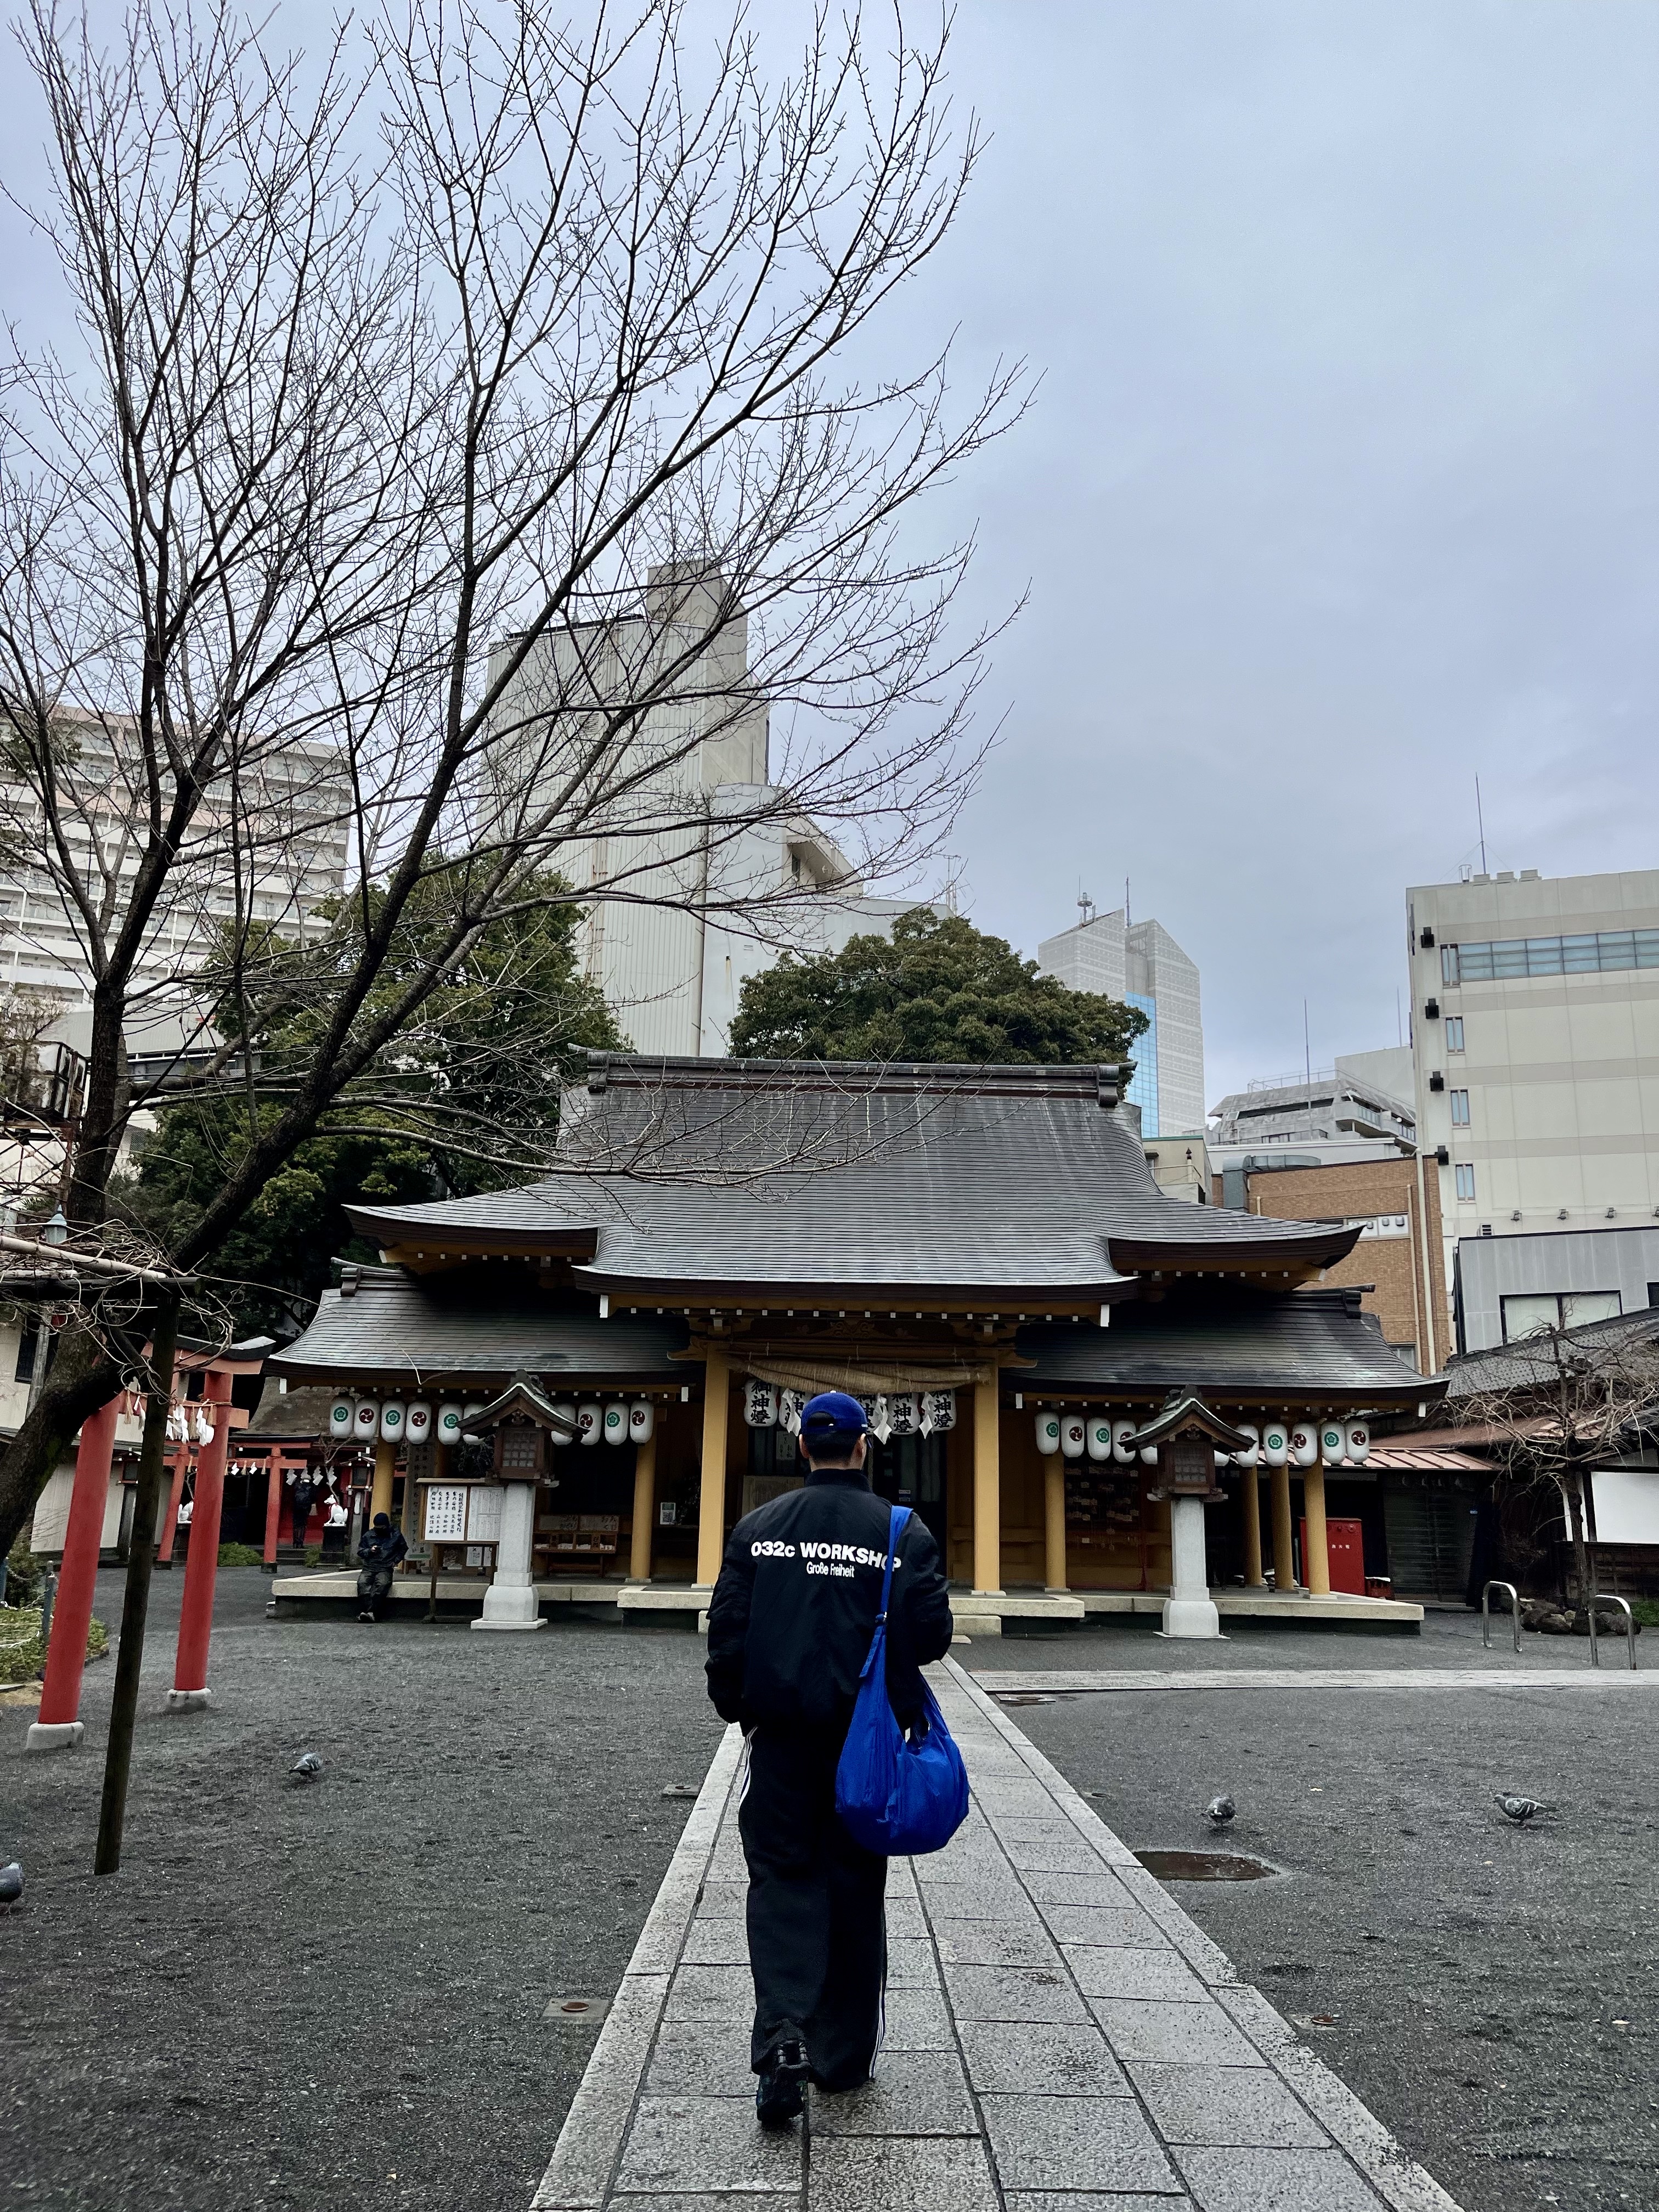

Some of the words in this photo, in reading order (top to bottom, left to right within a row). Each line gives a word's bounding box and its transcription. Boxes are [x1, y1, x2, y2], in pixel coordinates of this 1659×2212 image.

[750, 1381, 771, 1424] 御神燈
[751, 1541, 795, 1558] 032c
[806, 1561, 829, 1575] Große
[830, 1563, 855, 1578] Freiheit
